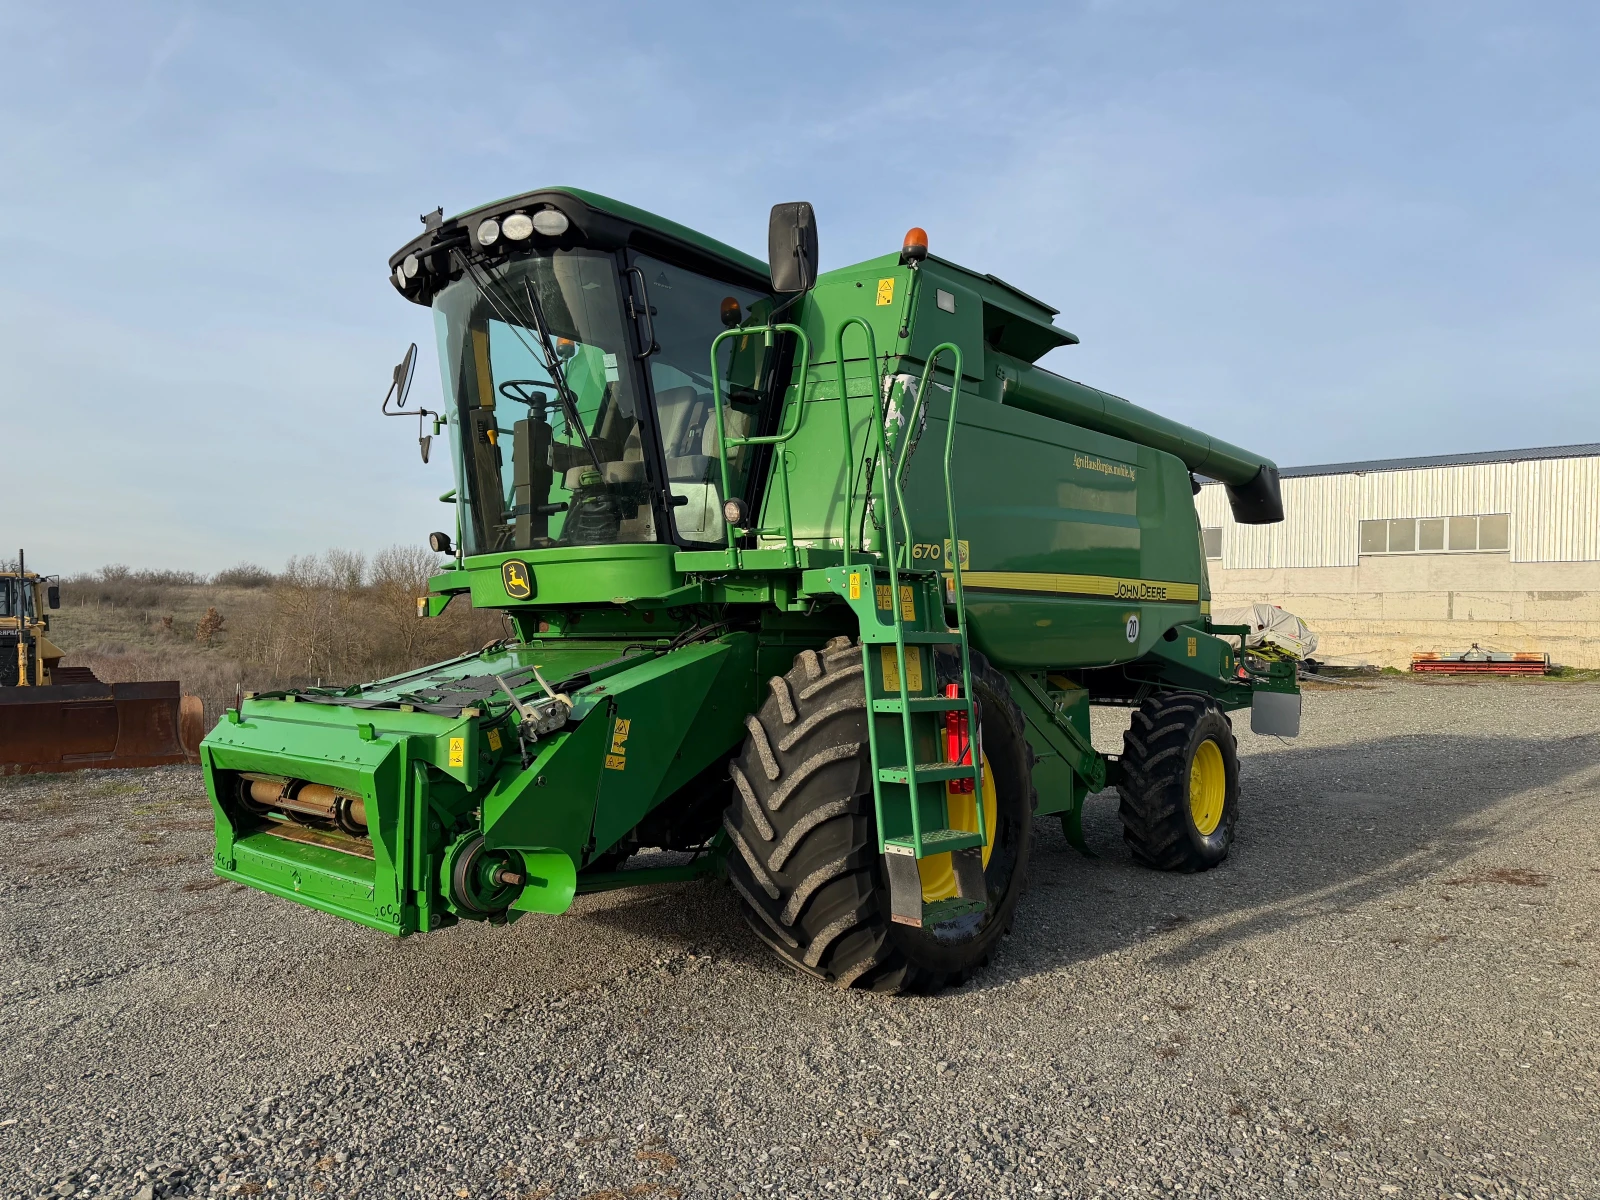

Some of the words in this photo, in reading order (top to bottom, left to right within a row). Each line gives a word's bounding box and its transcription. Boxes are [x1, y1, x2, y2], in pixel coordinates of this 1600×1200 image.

[1114, 581, 1139, 598] JOHN
[1140, 583, 1167, 600] DEERE
[1128, 619, 1137, 638] 20
